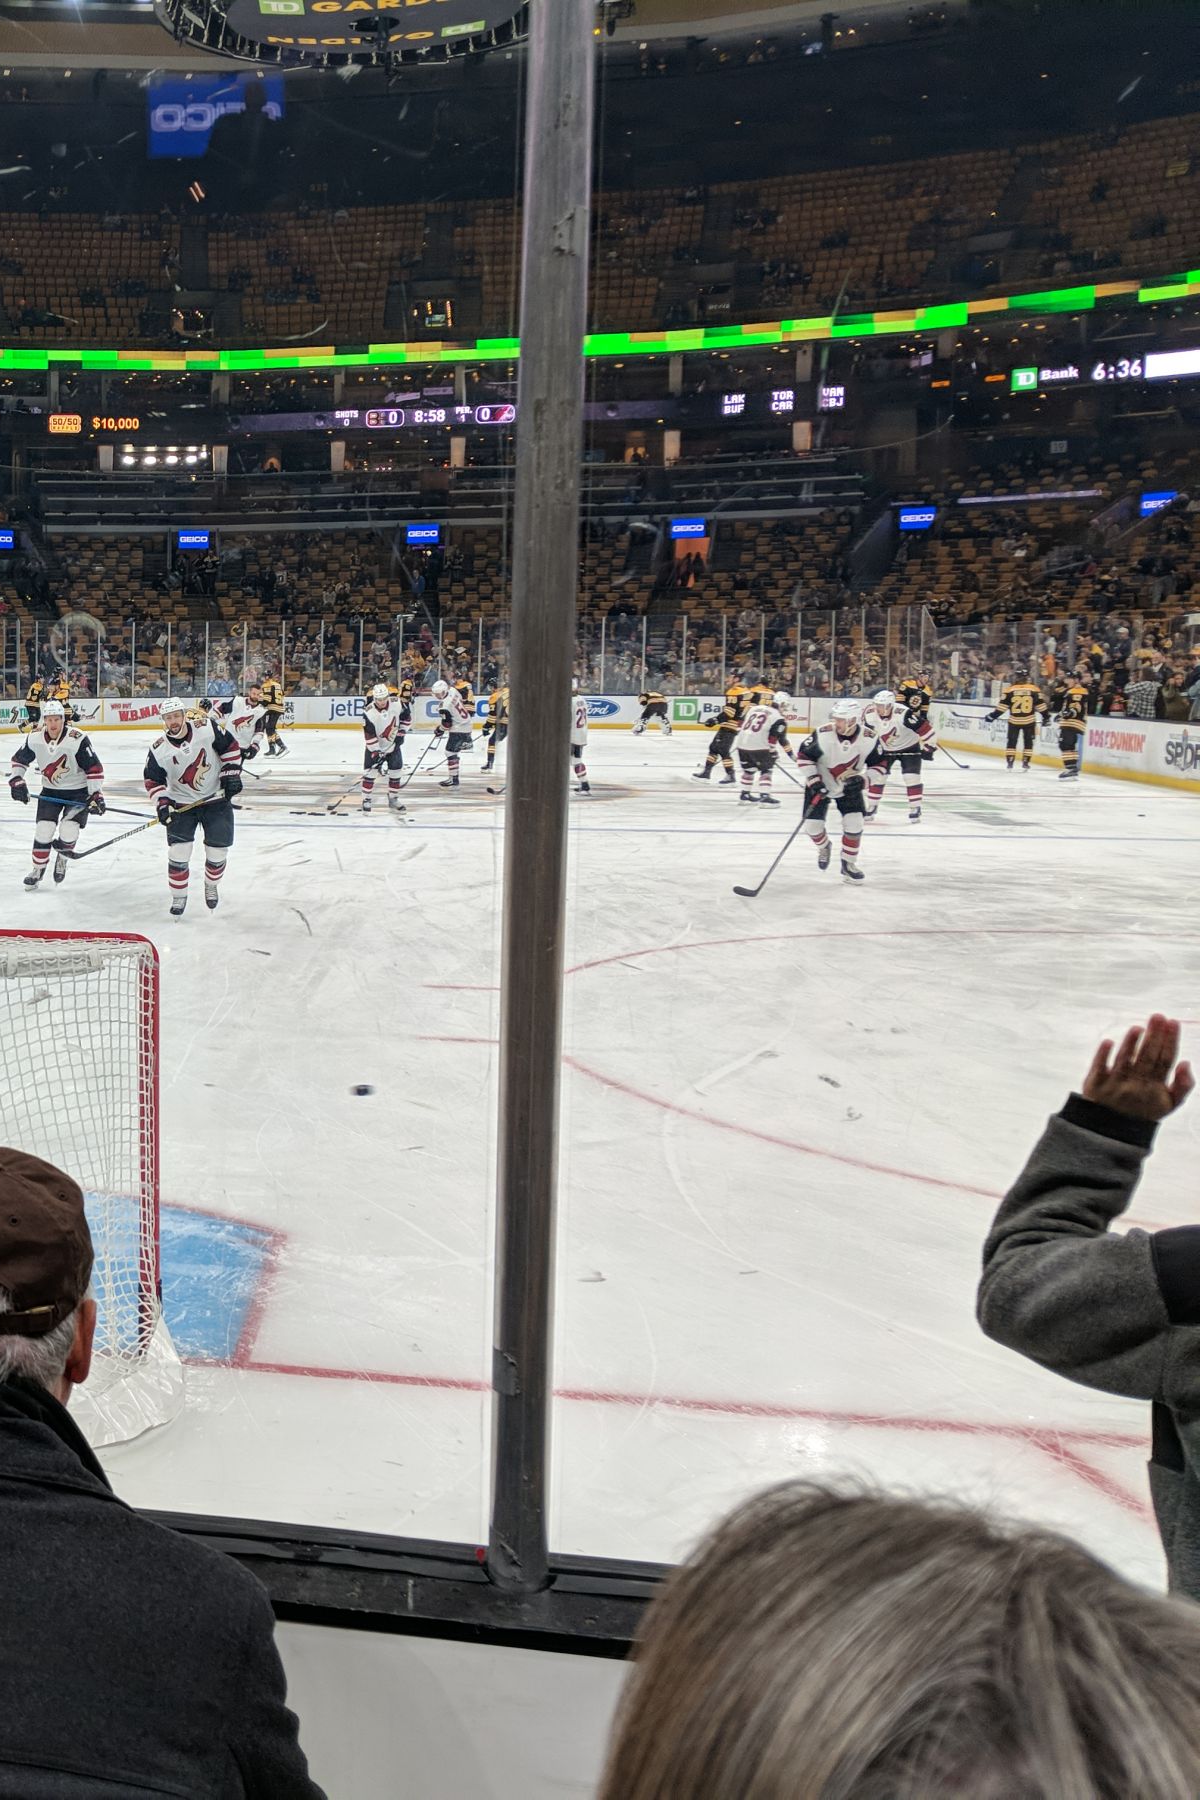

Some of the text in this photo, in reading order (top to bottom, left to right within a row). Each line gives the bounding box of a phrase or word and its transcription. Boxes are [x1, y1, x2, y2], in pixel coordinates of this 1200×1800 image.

[1092, 360, 1142, 380] 6:36
[1015, 372, 1035, 385] TD
[1040, 366, 1079, 381] Bank
[772, 391, 794, 400] TOR
[822, 387, 844, 397] VAN
[724, 394, 745, 404] LAK
[456, 406, 473, 414] PER.
[724, 404, 745, 414] BUF
[772, 401, 794, 411] CAR
[335, 410, 358, 418] SHOTS
[389, 411, 398, 424] 0
[414, 410, 446, 423] 8:58
[482, 408, 491, 420] 0
[52, 417, 78, 426] 50/50
[93, 417, 139, 431] $10,000
[344, 418, 350, 427] 0
[901, 513, 935, 522] GEICO
[672, 524, 704, 532] GEICO
[407, 530, 438, 538] GEICO
[328, 698, 366, 721] jetB
[675, 702, 721, 717] TD Ba
[1011, 695, 1033, 714] 28
[118, 703, 162, 722] W.B.MA
[743, 711, 767, 732] 83
